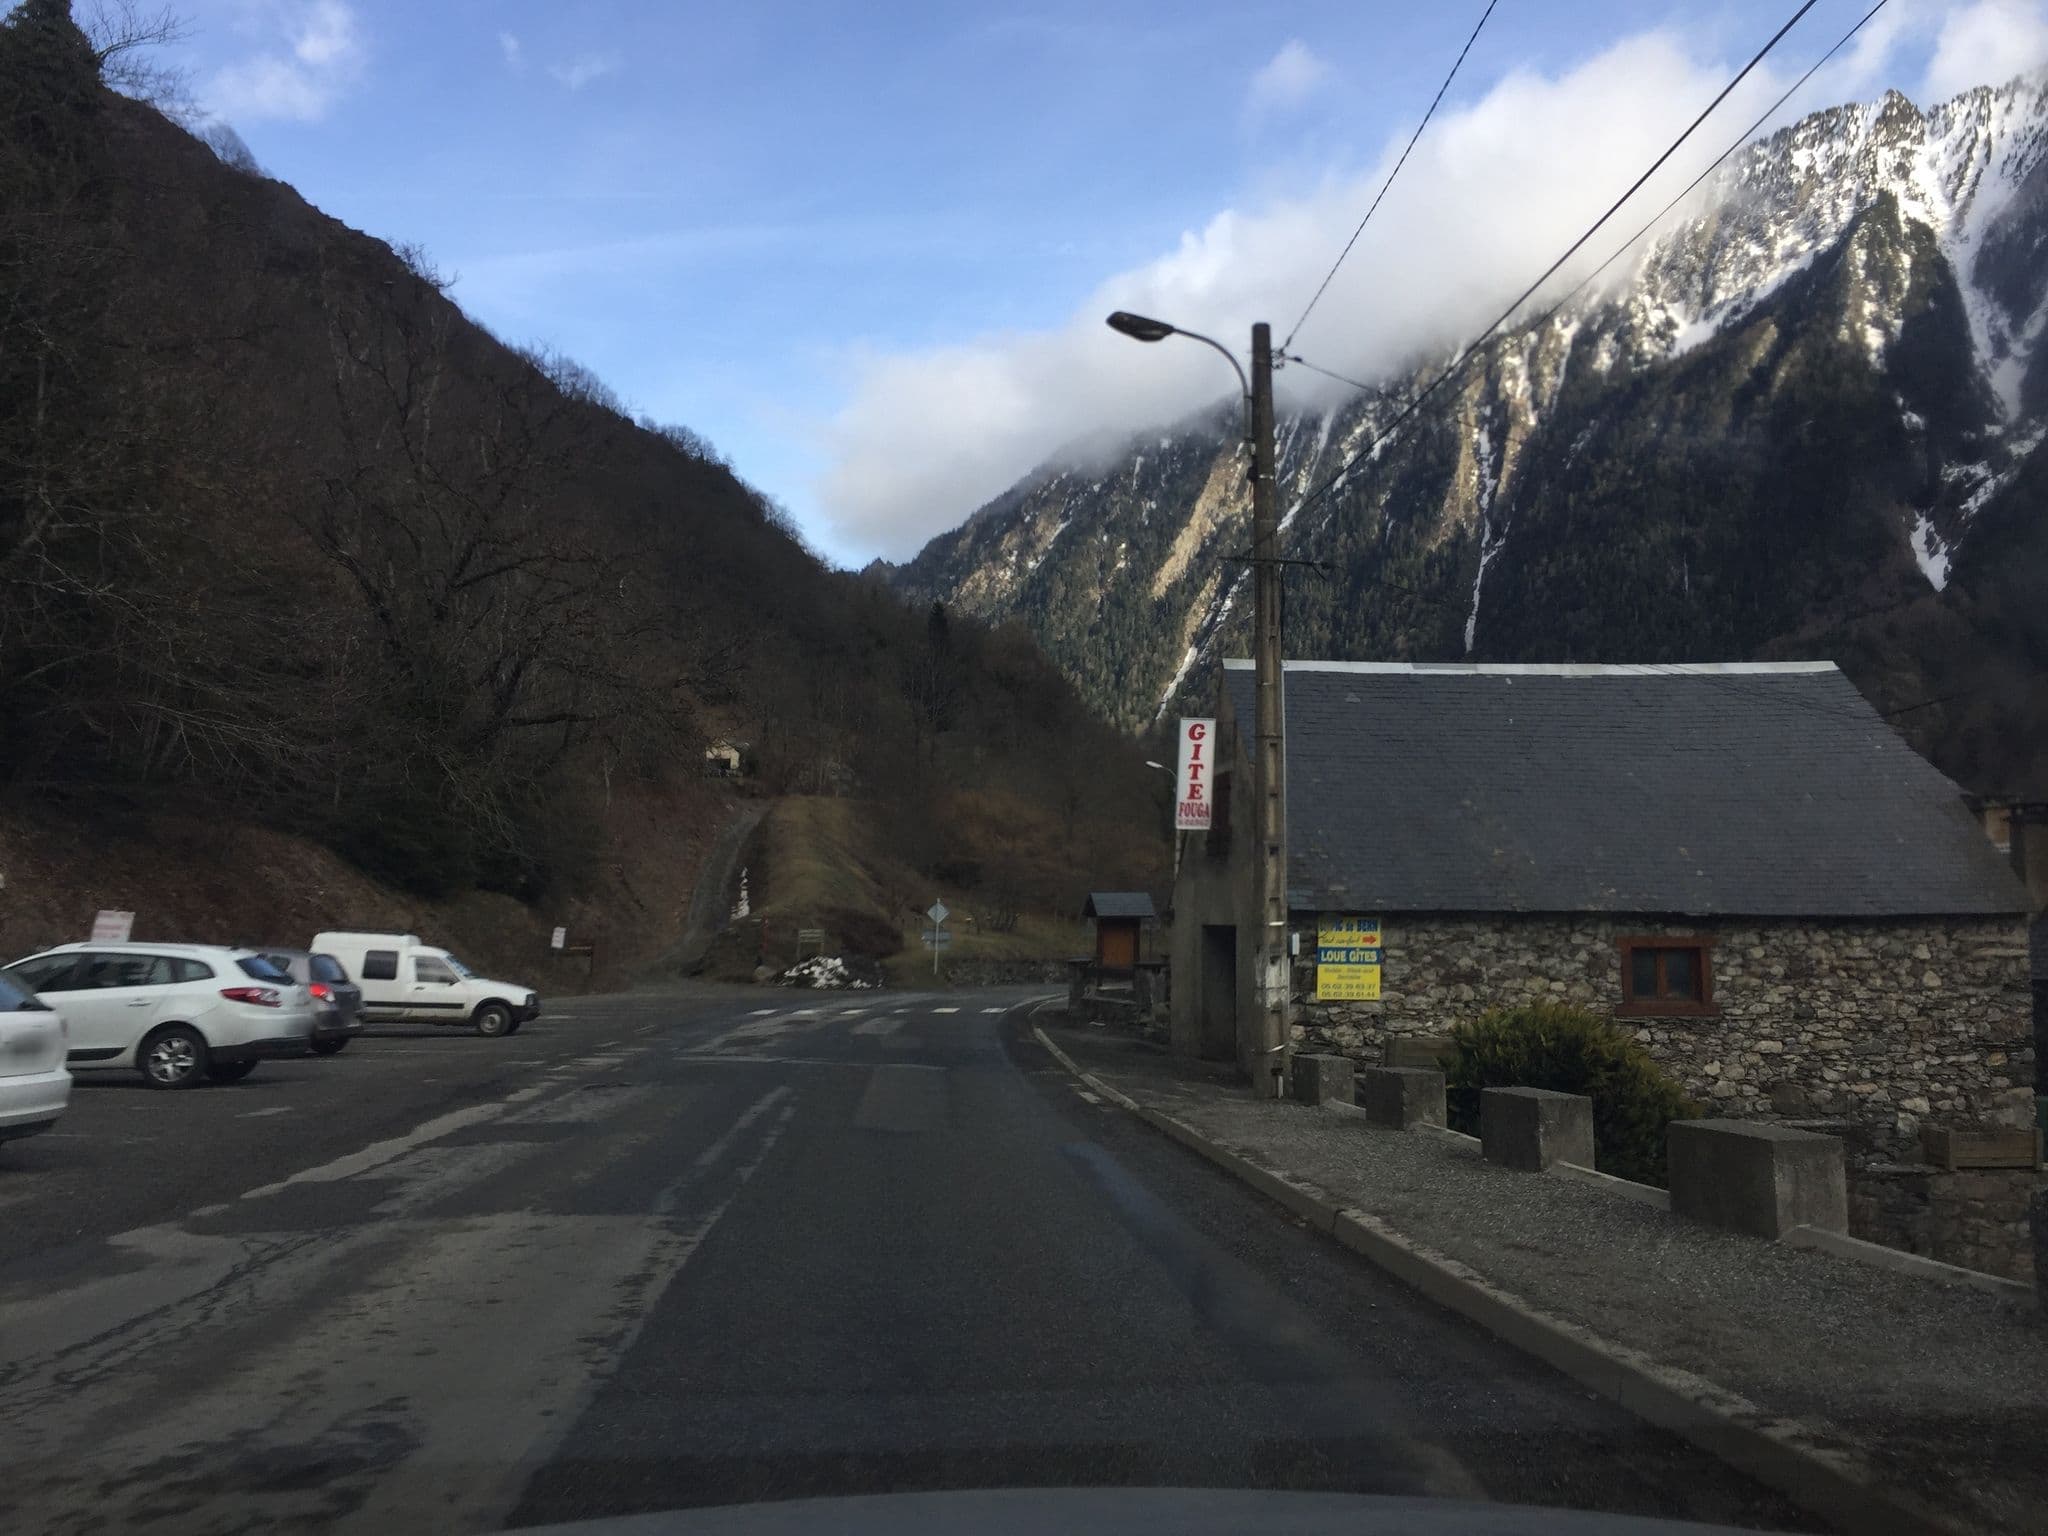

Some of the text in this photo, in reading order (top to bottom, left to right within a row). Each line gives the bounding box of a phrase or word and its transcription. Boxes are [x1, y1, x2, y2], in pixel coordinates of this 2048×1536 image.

[1186, 723, 1206, 800] GITE
[1178, 802, 1210, 818] FOUGA
[1321, 948, 1377, 962] LOUE GÎTES
